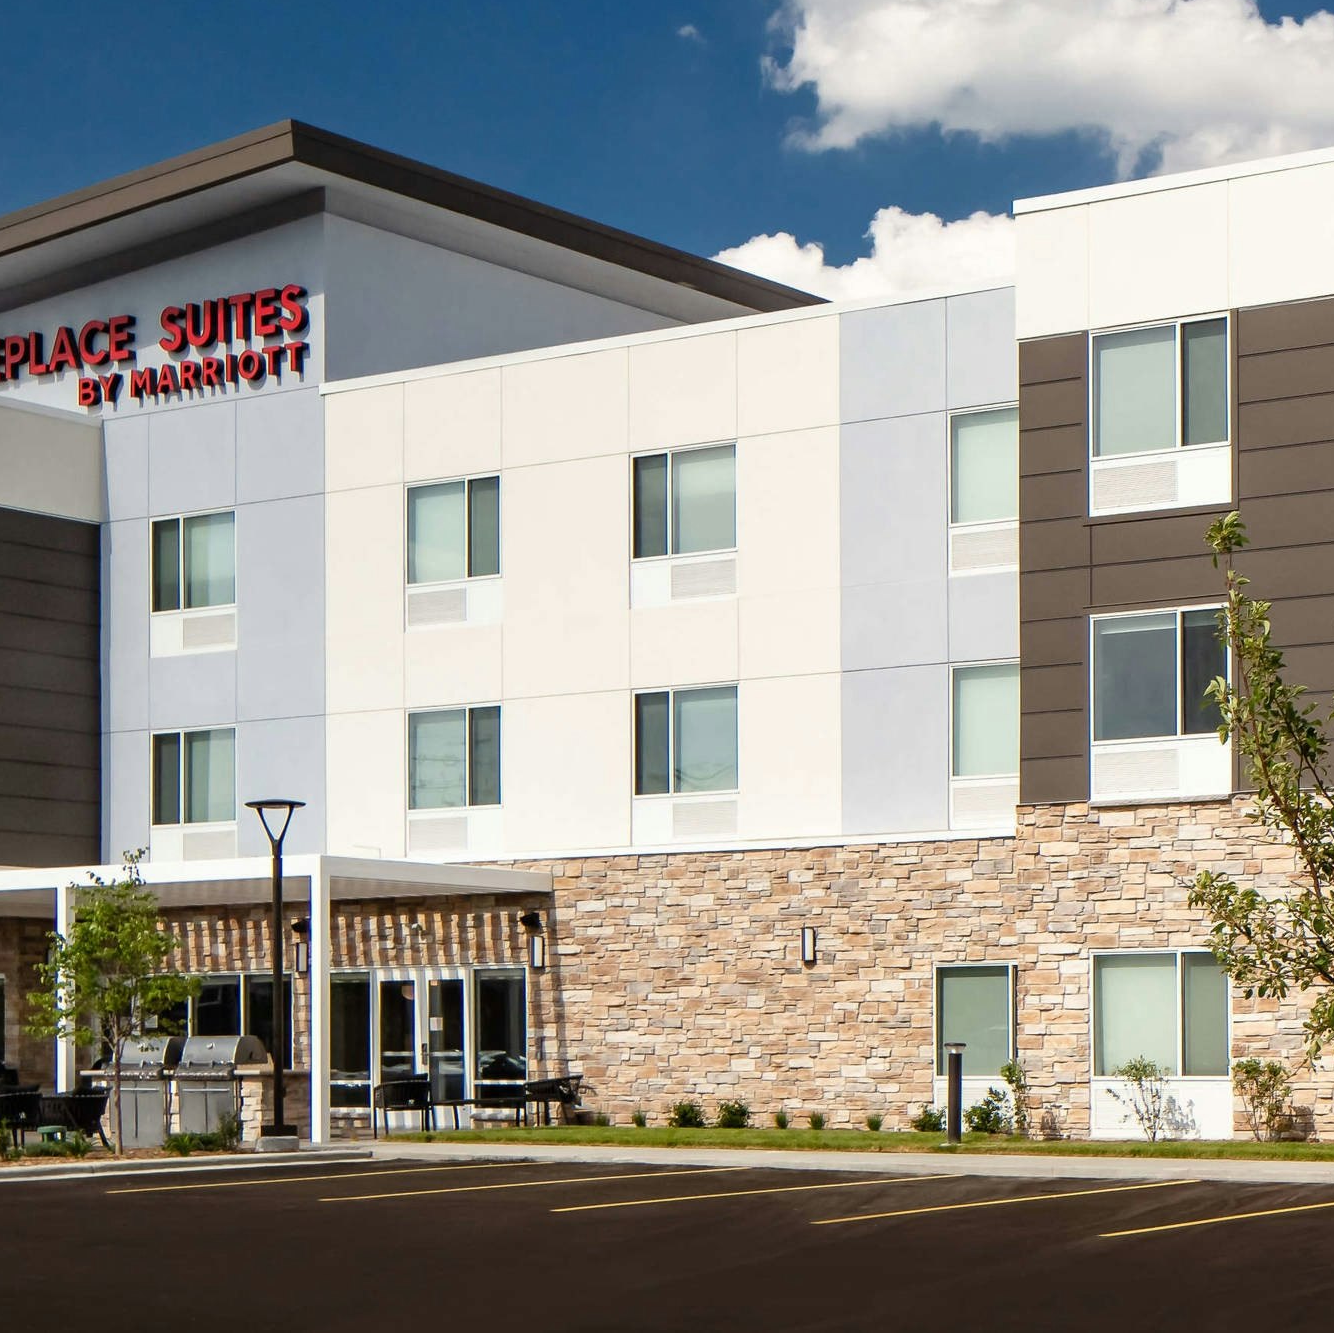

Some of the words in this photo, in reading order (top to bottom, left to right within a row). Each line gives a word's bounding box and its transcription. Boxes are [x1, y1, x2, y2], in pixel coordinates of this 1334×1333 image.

[159, 284, 307, 352] SUITES
[79, 374, 119, 407] BY
[130, 341, 307, 398] MARRIOTT
